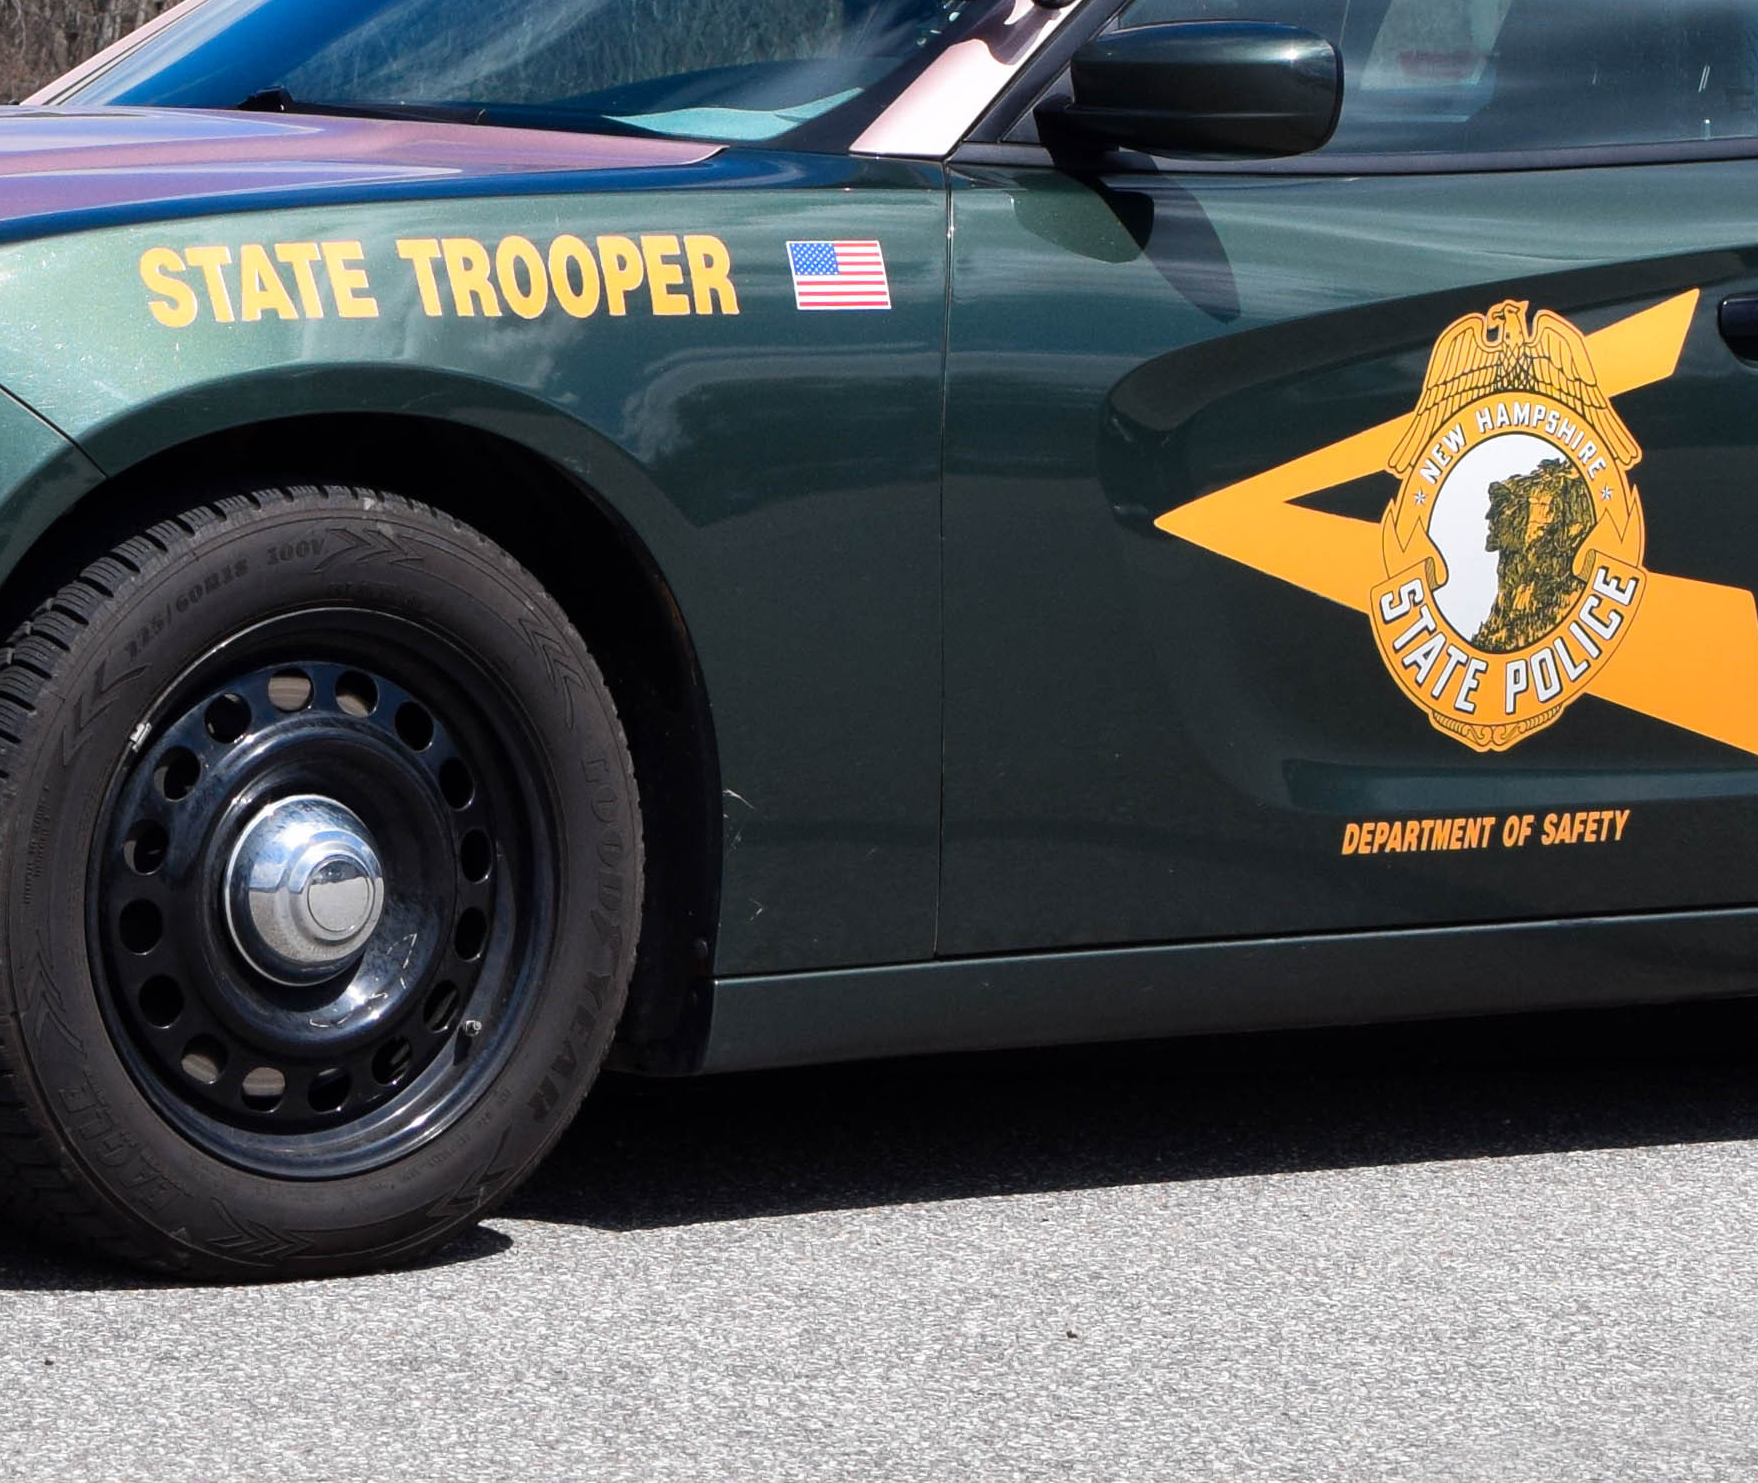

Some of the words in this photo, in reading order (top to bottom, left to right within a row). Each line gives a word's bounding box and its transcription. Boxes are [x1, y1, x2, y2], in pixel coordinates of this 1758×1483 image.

[140, 241, 380, 328] STATE
[396, 234, 740, 319] TROOPER
[1419, 423, 1467, 485] NEW
[1475, 401, 1607, 480] HAMPSHIRE
[1380, 577, 1488, 714] STATE
[1504, 565, 1640, 714] POLICE
[1342, 817, 1496, 855] DEPARTMENT
[1502, 814, 1535, 848] OF
[1541, 809, 1631, 846] SAFETY
